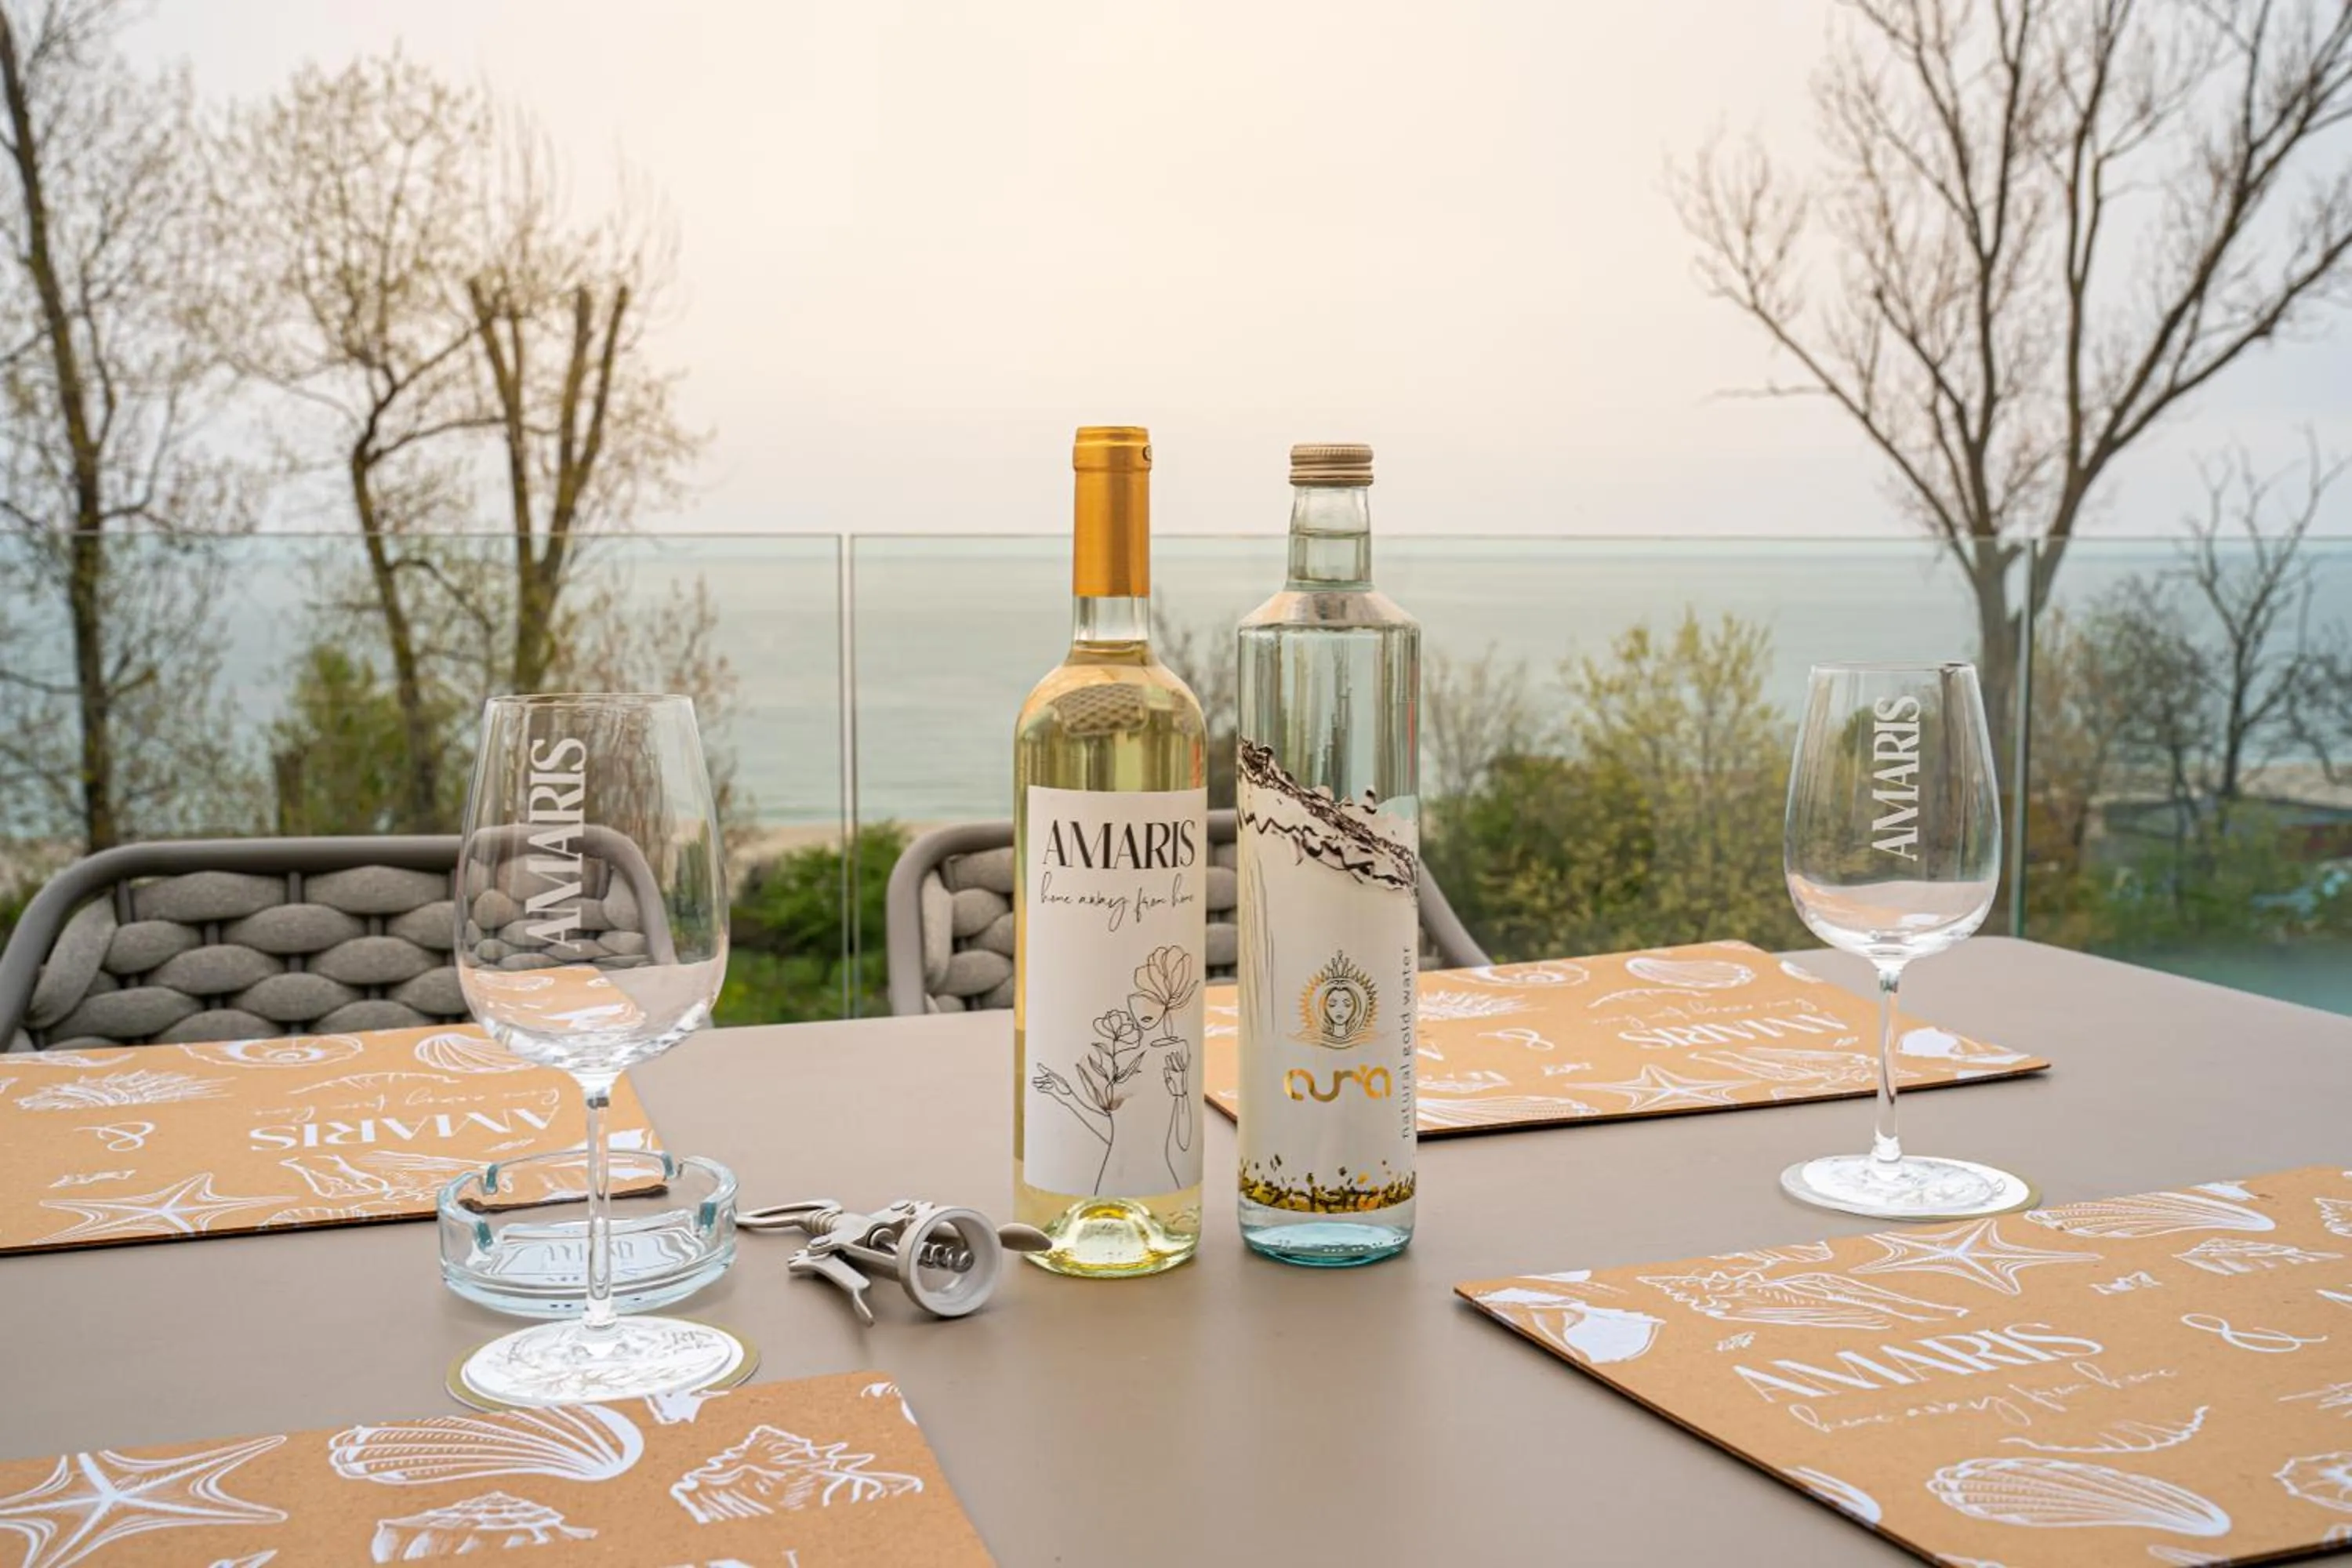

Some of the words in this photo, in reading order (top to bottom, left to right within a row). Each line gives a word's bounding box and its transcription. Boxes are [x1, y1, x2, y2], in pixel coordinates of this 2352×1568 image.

[1871, 695, 1921, 862] AMARIS
[525, 738, 586, 953] AMARIS
[1041, 819, 1196, 869] AMARIS
[1402, 947, 1412, 1006] water
[1399, 1012, 1411, 1057] gold
[1617, 1011, 1849, 1050] AMARIS
[249, 1105, 559, 1151] AMARIS
[1398, 1063, 1411, 1139] natural
[1733, 1323, 2105, 1403] AMARIS
